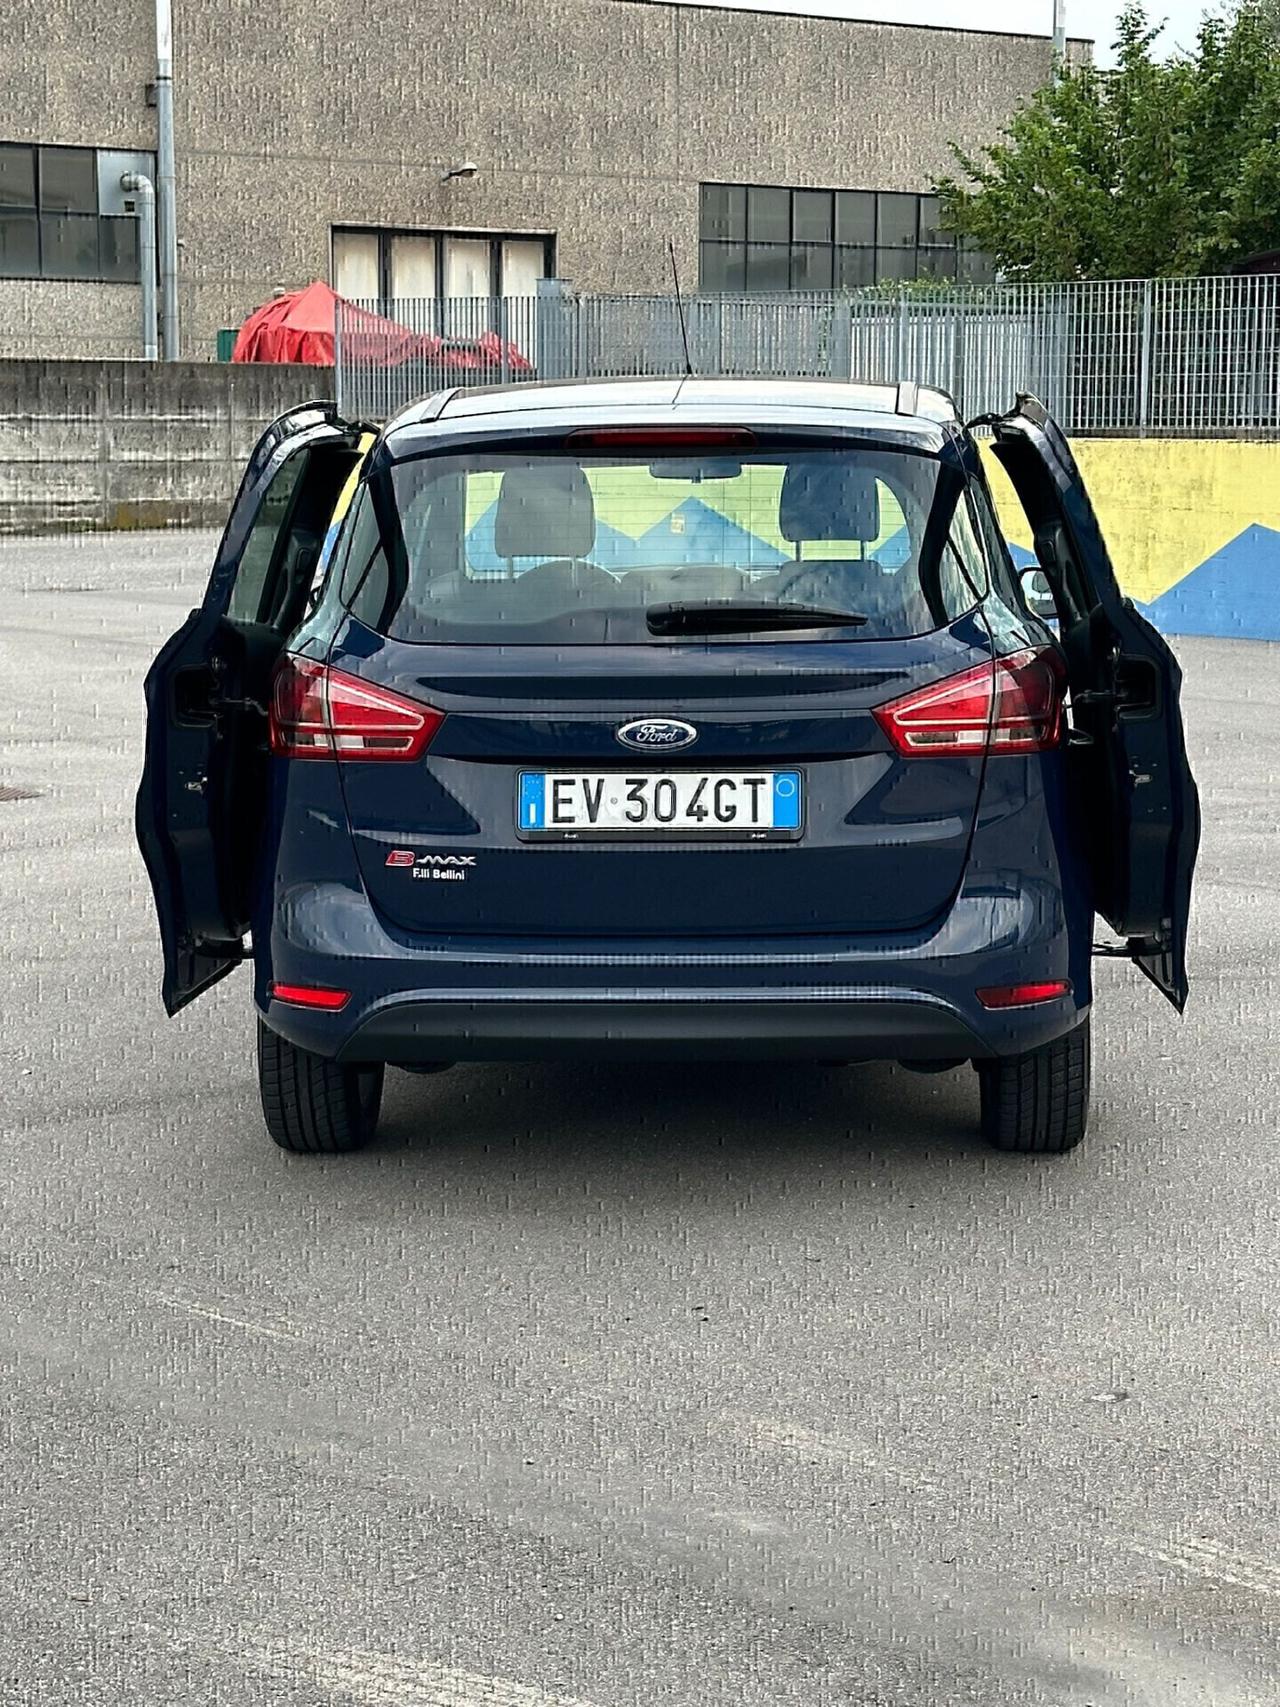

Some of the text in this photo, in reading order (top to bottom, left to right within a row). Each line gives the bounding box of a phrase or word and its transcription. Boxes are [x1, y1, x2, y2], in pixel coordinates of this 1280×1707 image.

[636, 724, 679, 742] Ford
[552, 777, 767, 823] EV 304GT
[432, 869, 465, 881] Bellini
